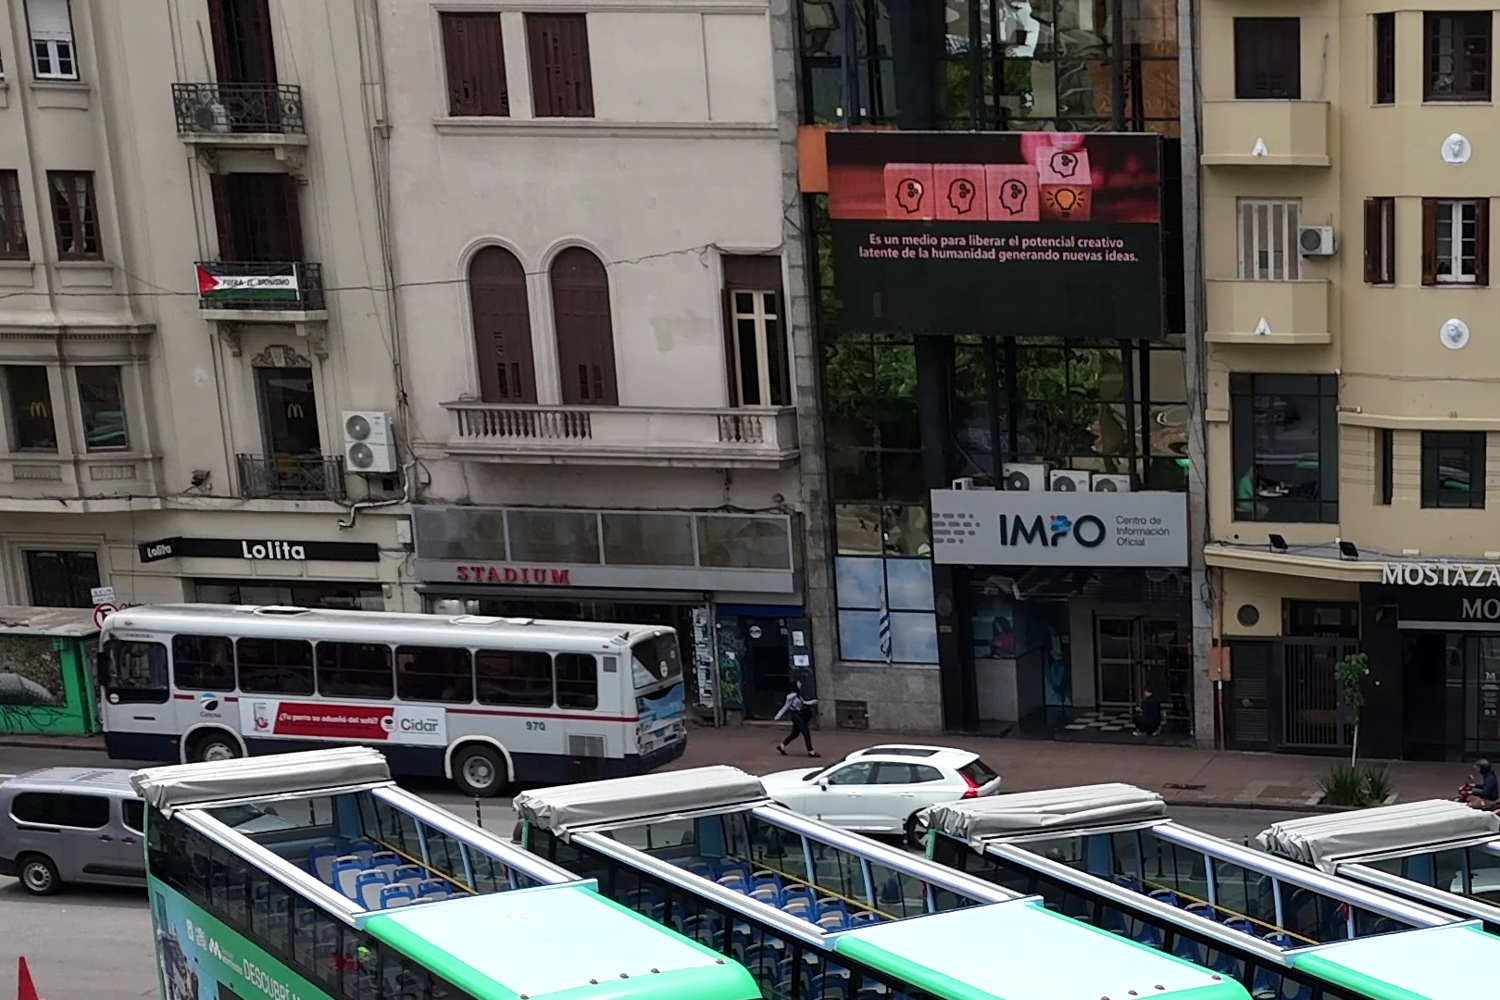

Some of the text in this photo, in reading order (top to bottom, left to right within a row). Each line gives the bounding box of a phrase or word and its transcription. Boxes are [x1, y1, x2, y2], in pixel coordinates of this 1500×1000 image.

[869, 233, 1124, 249] Es un medio para liberar el potencial creativo
[859, 246, 1139, 262] latente de la humanidad generando nuevas ideas.
[1115, 515, 1162, 526] Centro de
[999, 514, 1107, 548] IMPO
[1115, 526, 1170, 536] Información
[241, 540, 306, 560] Lolita
[1116, 537, 1146, 547] Oficial
[147, 543, 172, 559] Lolita
[456, 566, 571, 585] STADIUM
[400, 718, 439, 733] Cidar
[525, 720, 546, 732] 970
